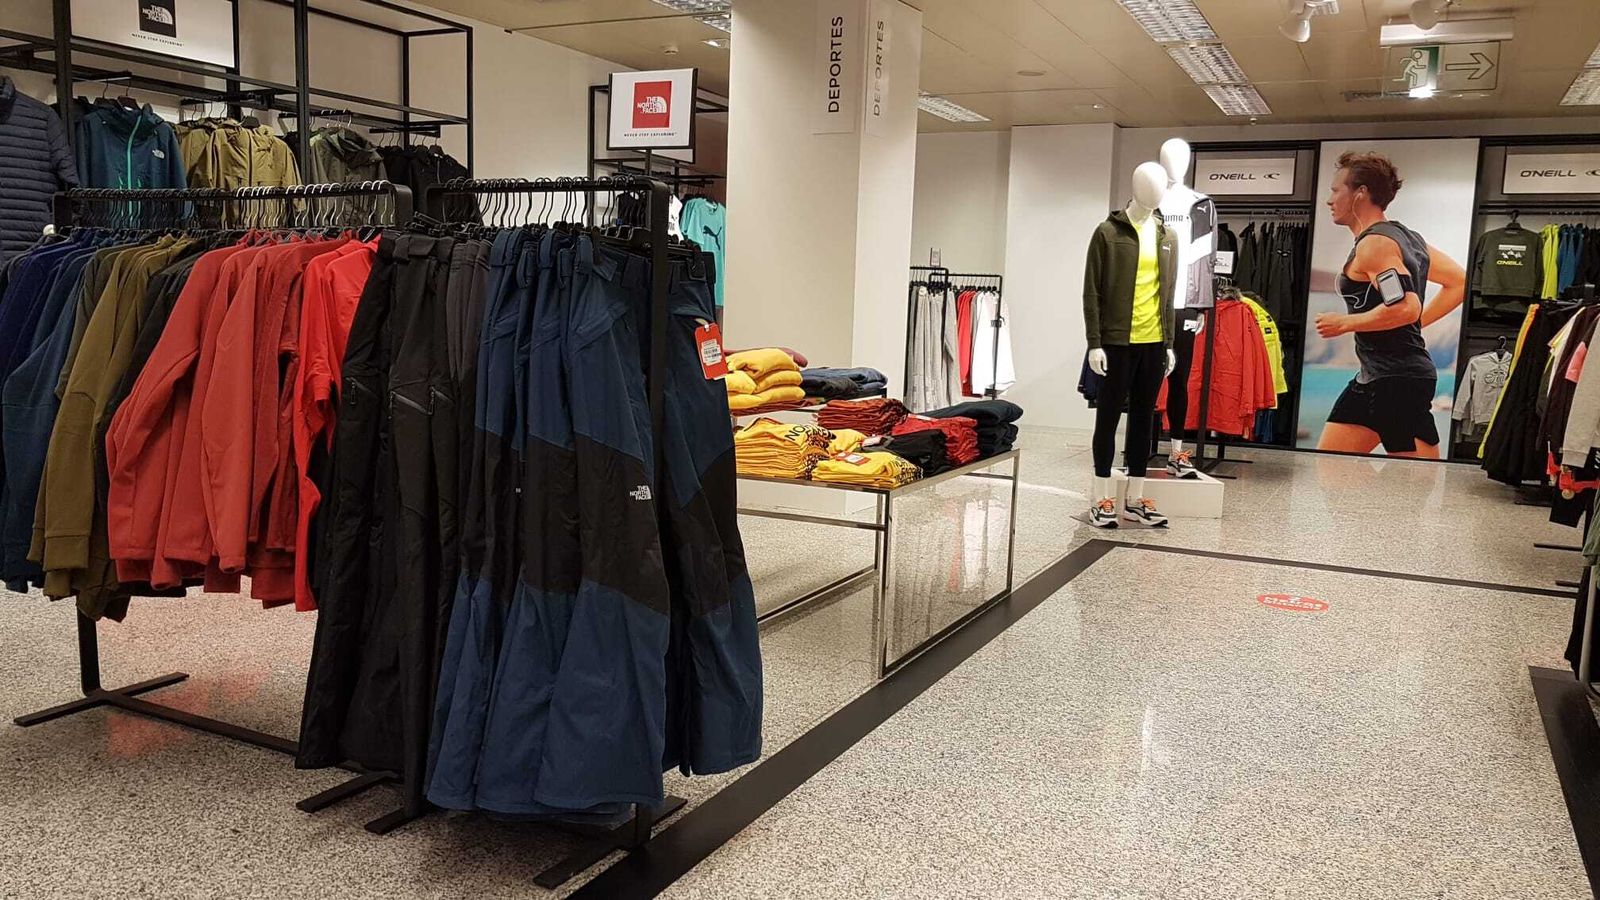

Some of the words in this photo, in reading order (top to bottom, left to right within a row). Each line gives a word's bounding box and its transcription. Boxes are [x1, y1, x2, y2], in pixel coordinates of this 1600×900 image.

[645, 96, 658, 104] THE
[828, 16, 843, 113] DEPORTES
[873, 20, 885, 116] DEPORTES
